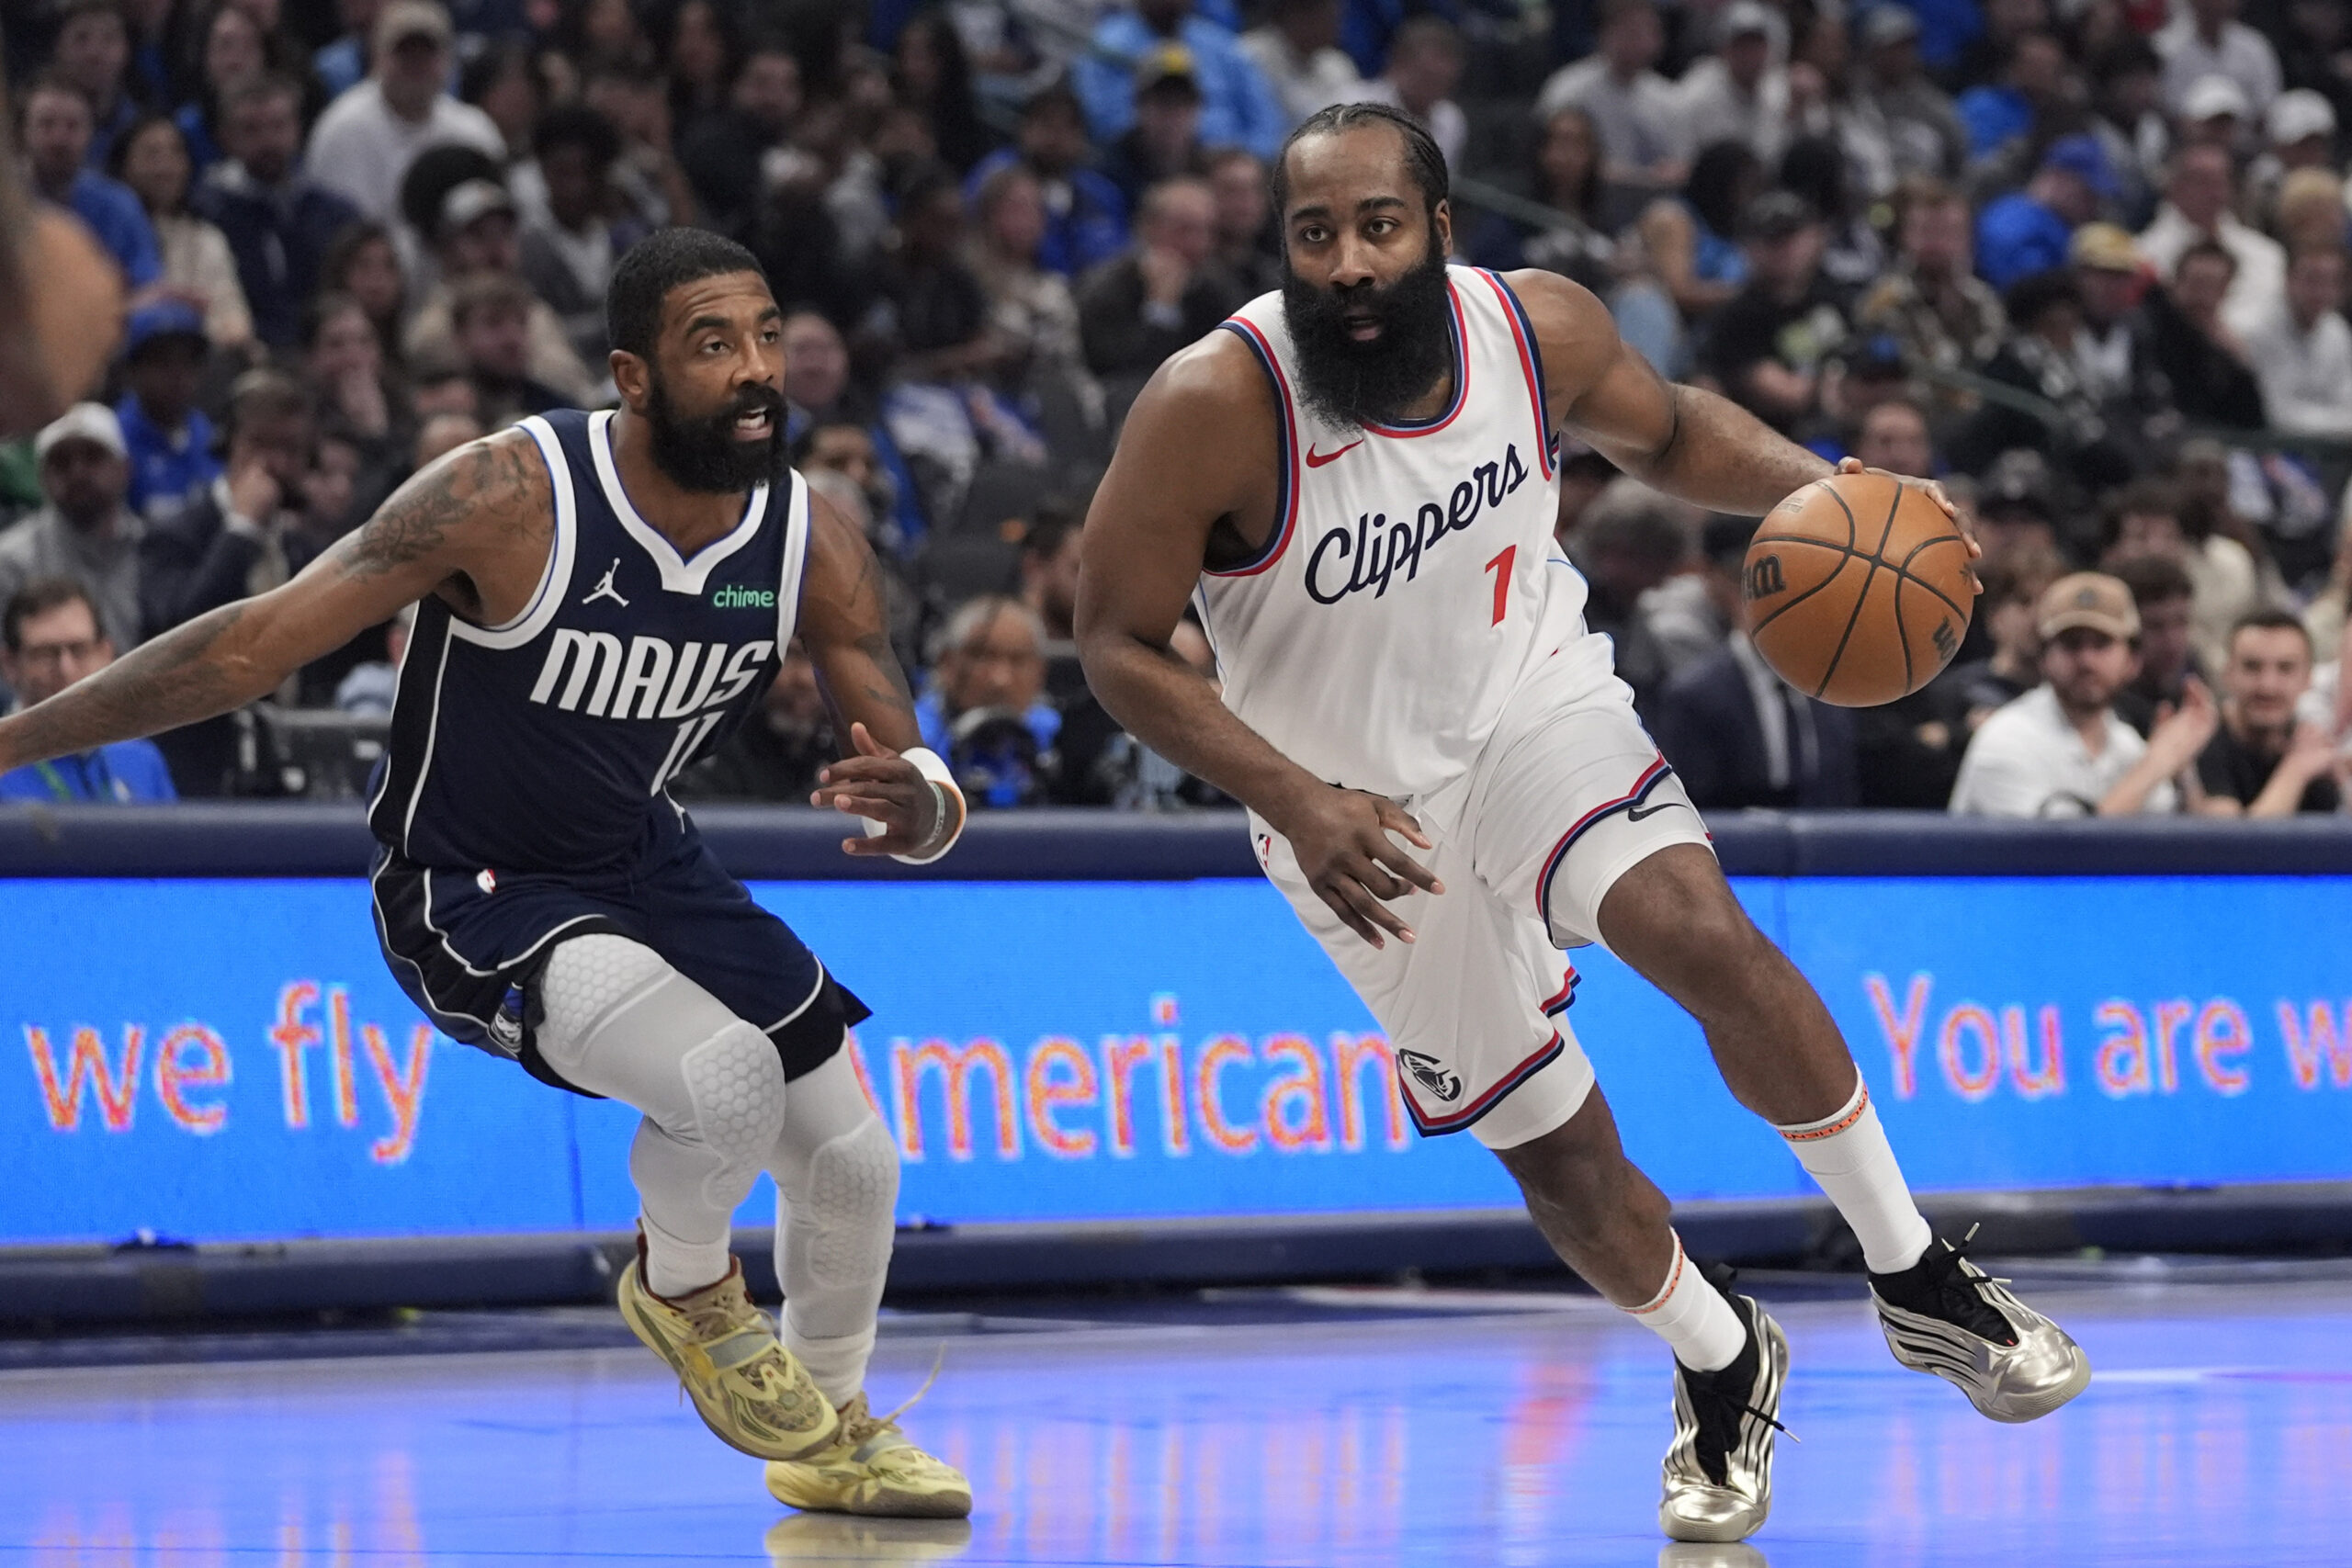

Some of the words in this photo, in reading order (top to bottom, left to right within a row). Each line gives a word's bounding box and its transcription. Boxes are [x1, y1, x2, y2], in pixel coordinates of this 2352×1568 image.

[1305, 442, 1530, 605] Clippers
[713, 584, 775, 607] chime
[1484, 543, 1517, 628] 1
[529, 626, 775, 719] MAVS
[650, 710, 727, 797] 11
[24, 1021, 233, 1132] we
[266, 980, 435, 1165] fly
[847, 994, 1408, 1159] merican
[1863, 972, 2064, 1099] You
[2095, 998, 2251, 1095] are
